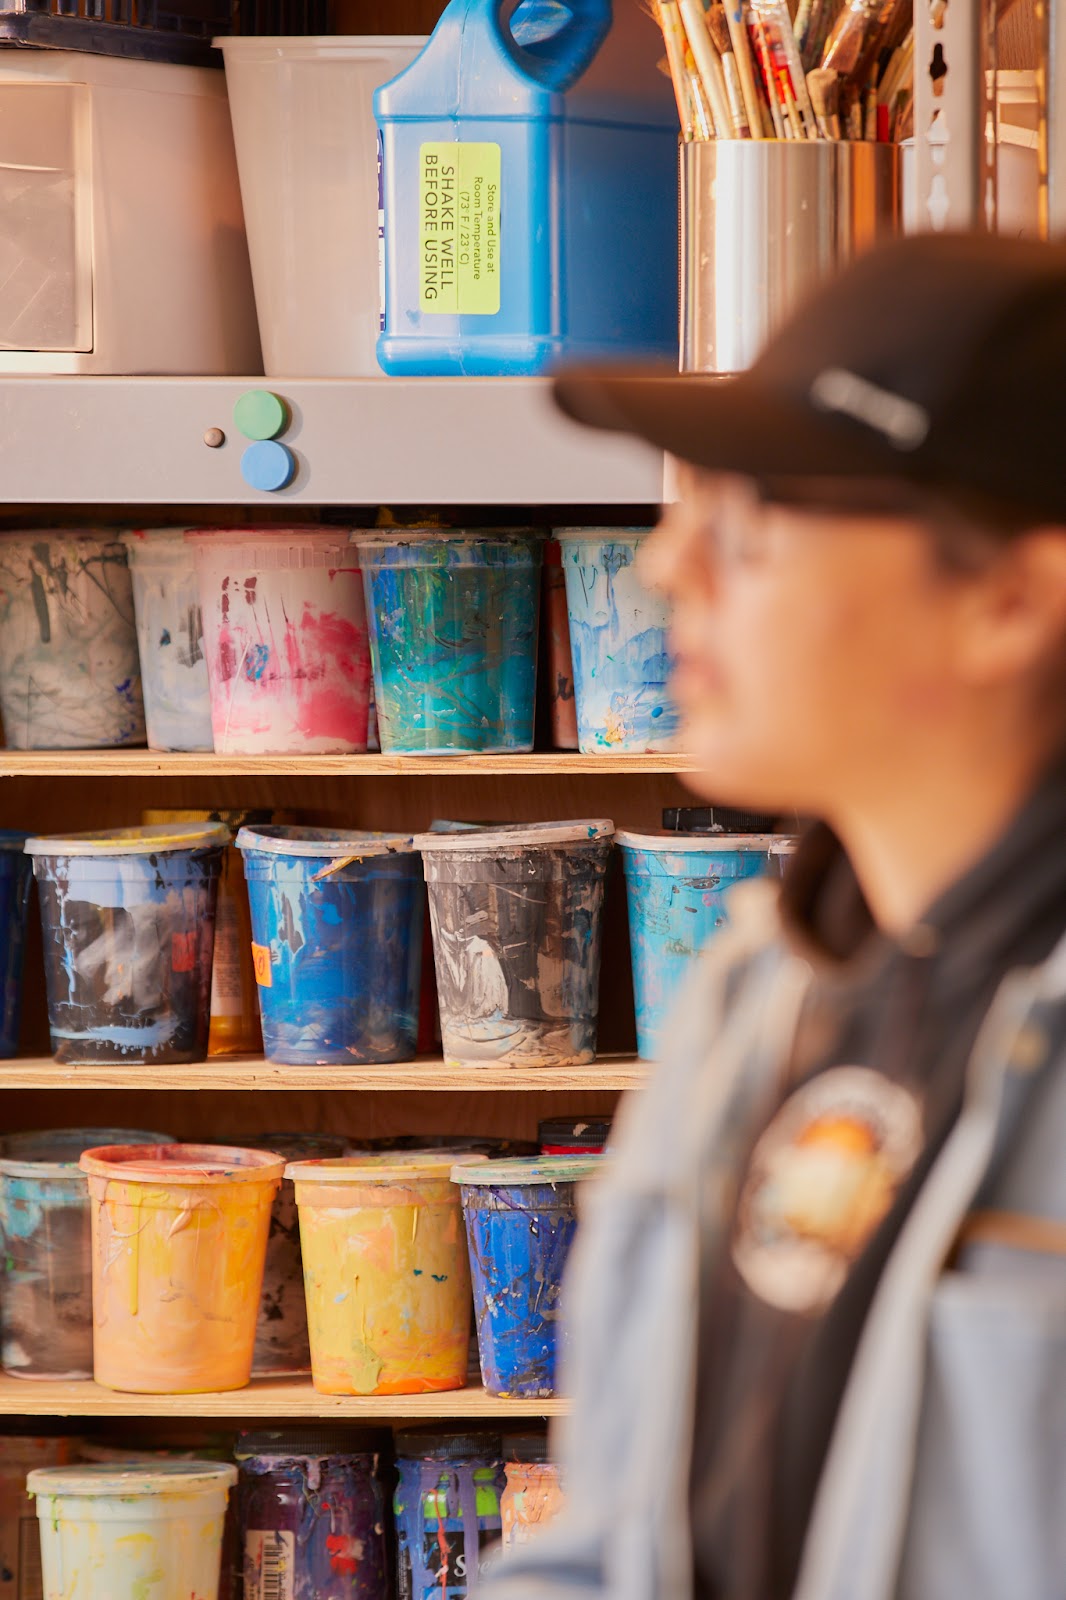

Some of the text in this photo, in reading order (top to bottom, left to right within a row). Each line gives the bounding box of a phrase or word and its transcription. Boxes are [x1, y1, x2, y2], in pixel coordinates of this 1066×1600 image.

[425, 156, 437, 300] BEFORE USING
[442, 166, 454, 290] SHAKE WELL
[472, 177, 482, 280] Room Temperature
[487, 184, 496, 272] Store and Use at
